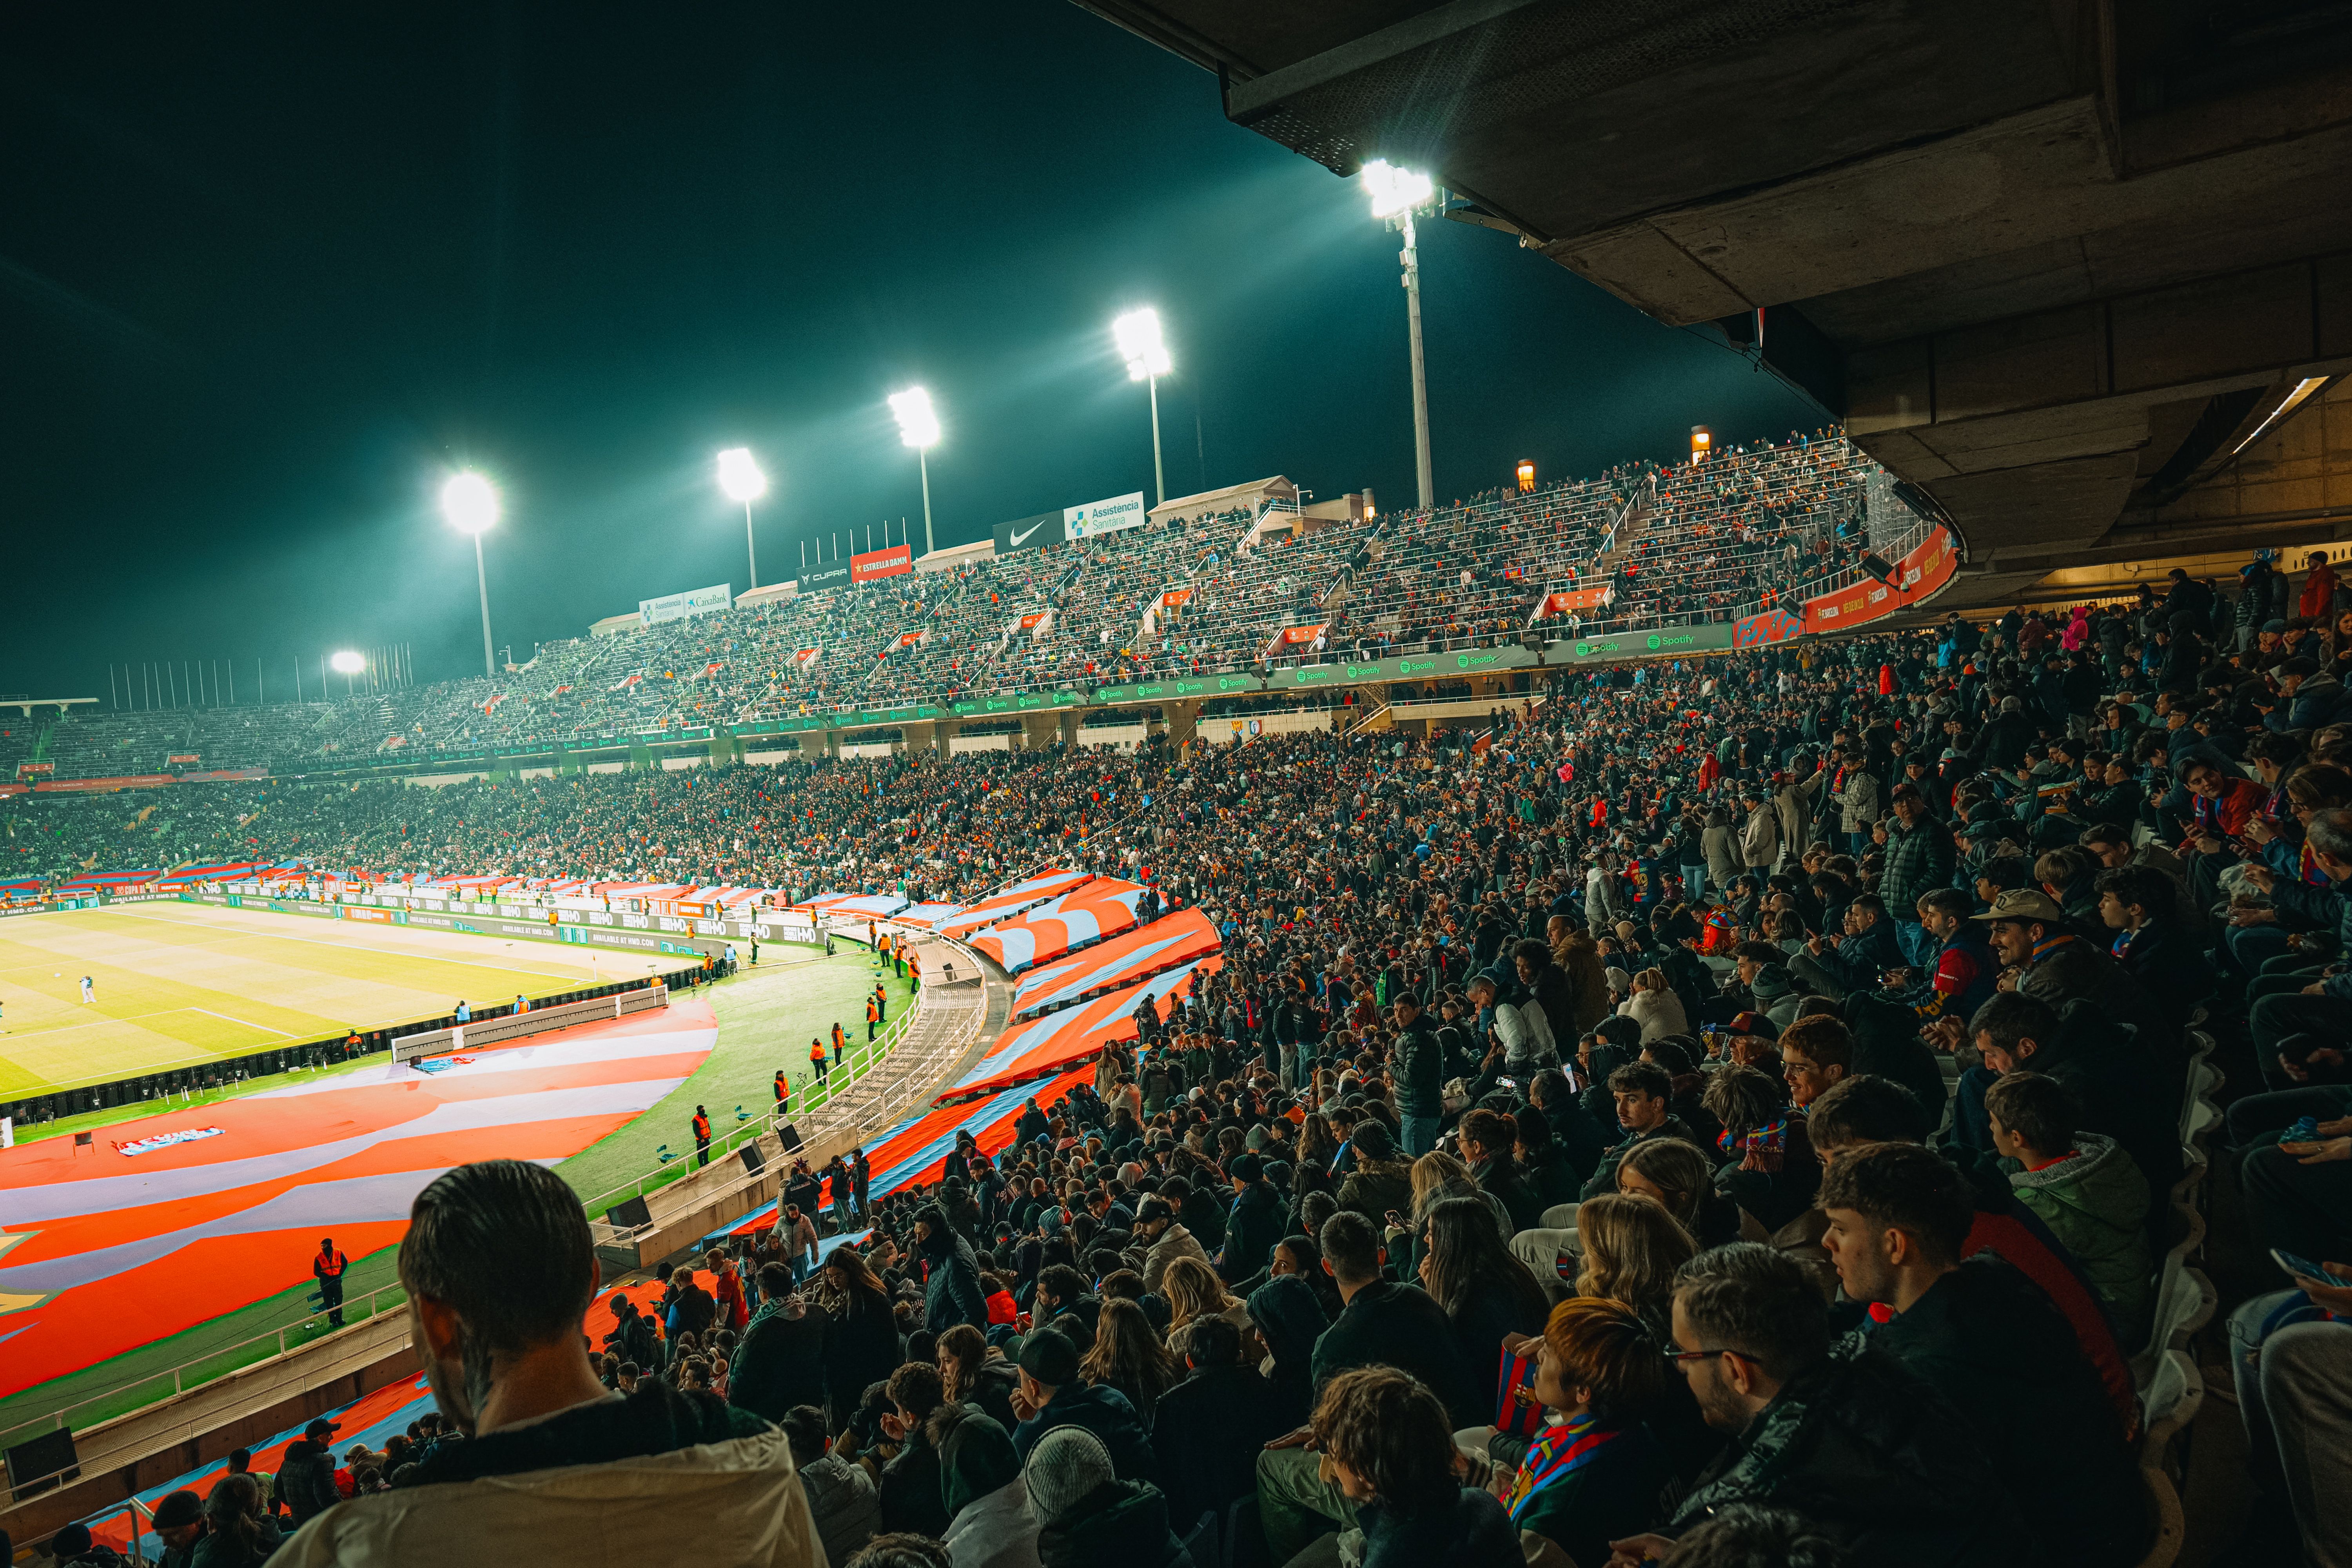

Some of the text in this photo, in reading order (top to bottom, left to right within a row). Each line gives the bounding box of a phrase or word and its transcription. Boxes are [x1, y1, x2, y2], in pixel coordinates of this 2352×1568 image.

[1093, 500, 1138, 519] Assistència
[1093, 515, 1125, 530] Sanitària
[863, 556, 907, 572] ESTRELLA DAMM
[813, 568, 847, 581] CUPRA
[655, 599, 681, 610] Assistència
[696, 593, 727, 607] CaixaBank
[1663, 635, 1693, 645] Spotify
[1590, 643, 1619, 653] Spotify
[1470, 655, 1495, 665] Spotify
[1358, 667, 1380, 675] Spotify
[1412, 662, 1435, 671] Spotify
[125, 885, 138, 894] COPA
[150, 884, 158, 893] REY
[7, 906, 45, 915] HMD.COM
[482, 904, 493, 915] HMD
[510, 906, 521, 917] HMD
[536, 908, 549, 920] HMD
[568, 910, 580, 922] HMD
[599, 912, 613, 926] HMD
[633, 915, 648, 929] HMD
[503, 925, 524, 933] AVAILABLE
[670, 918, 686, 931] HMD
[710, 921, 726, 935] HMD
[751, 924, 770, 939] HMD
[798, 927, 816, 943] HMD
[593, 934, 619, 944] AVAILABLE
[628, 937, 654, 946] HMD.COM
